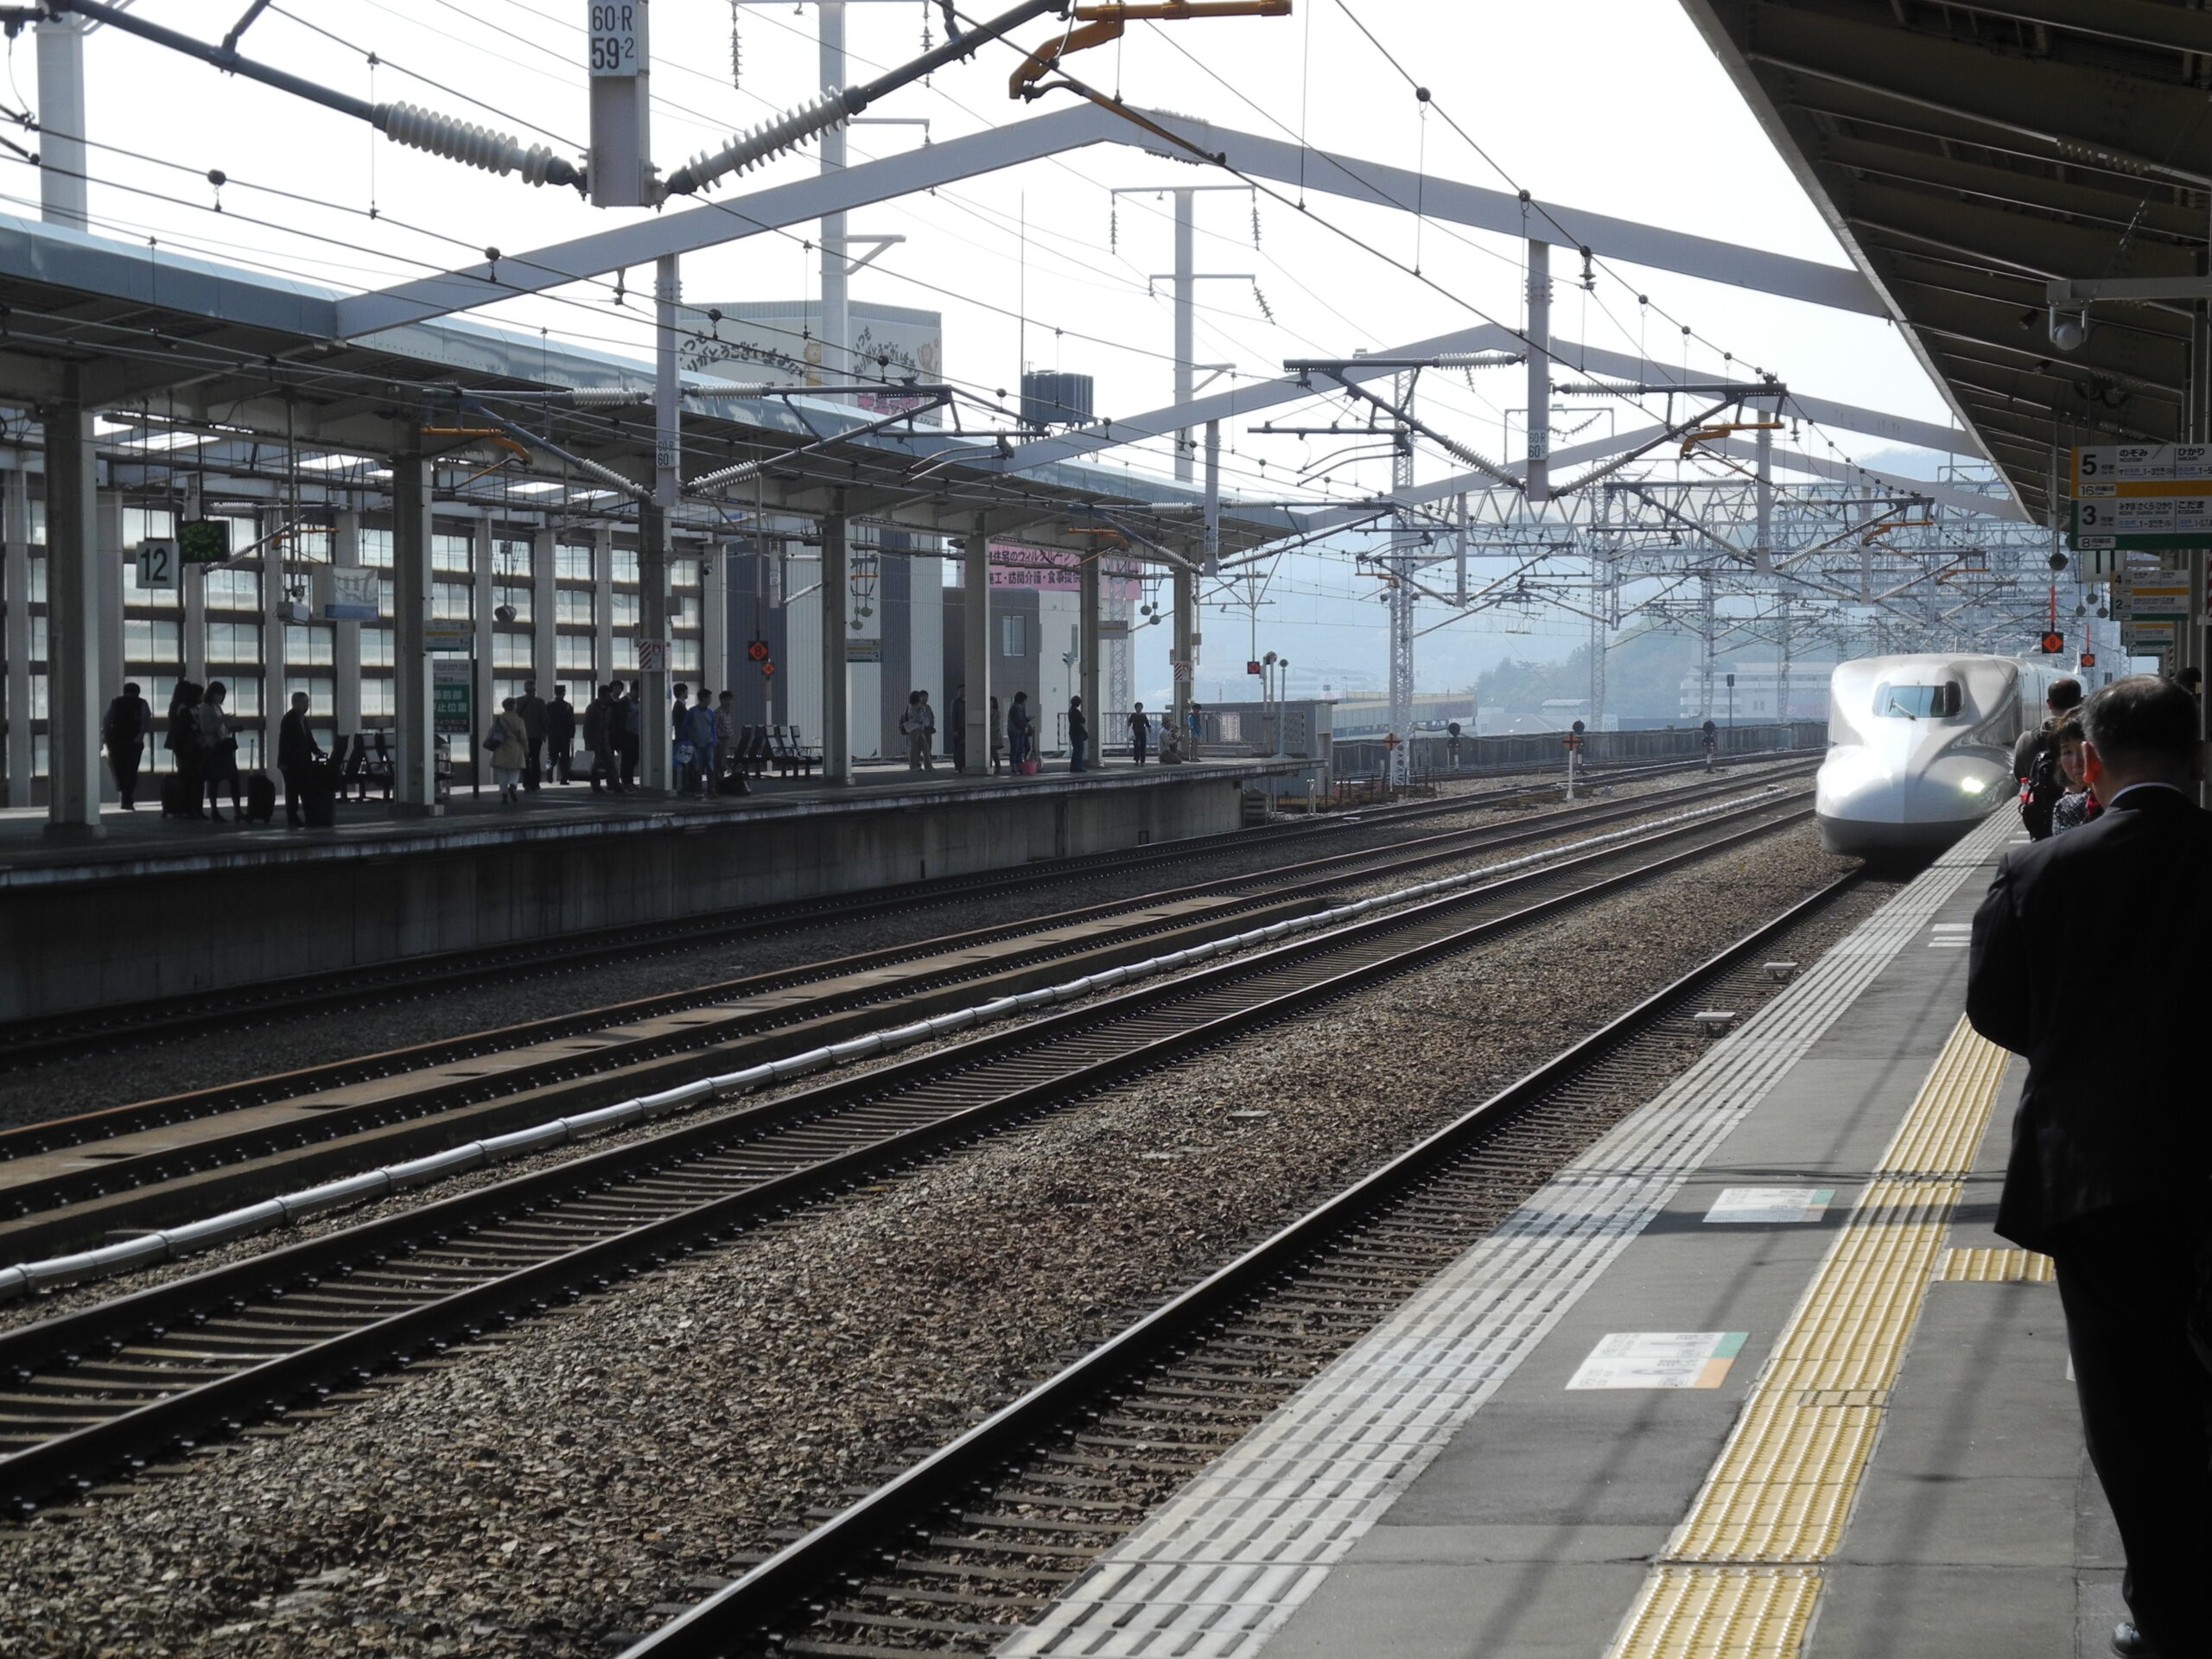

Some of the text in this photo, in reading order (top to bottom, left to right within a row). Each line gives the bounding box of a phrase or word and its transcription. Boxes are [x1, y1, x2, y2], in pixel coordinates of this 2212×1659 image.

[2082, 454, 2097, 475] 5
[2081, 486, 2094, 496] 16
[2082, 505, 2097, 525] 3
[2082, 537, 2090, 548] 8
[140, 547, 168, 582] 12
[2114, 575, 2122, 585] 4
[2115, 599, 2123, 609] 2
[754, 645, 762, 657] 8
